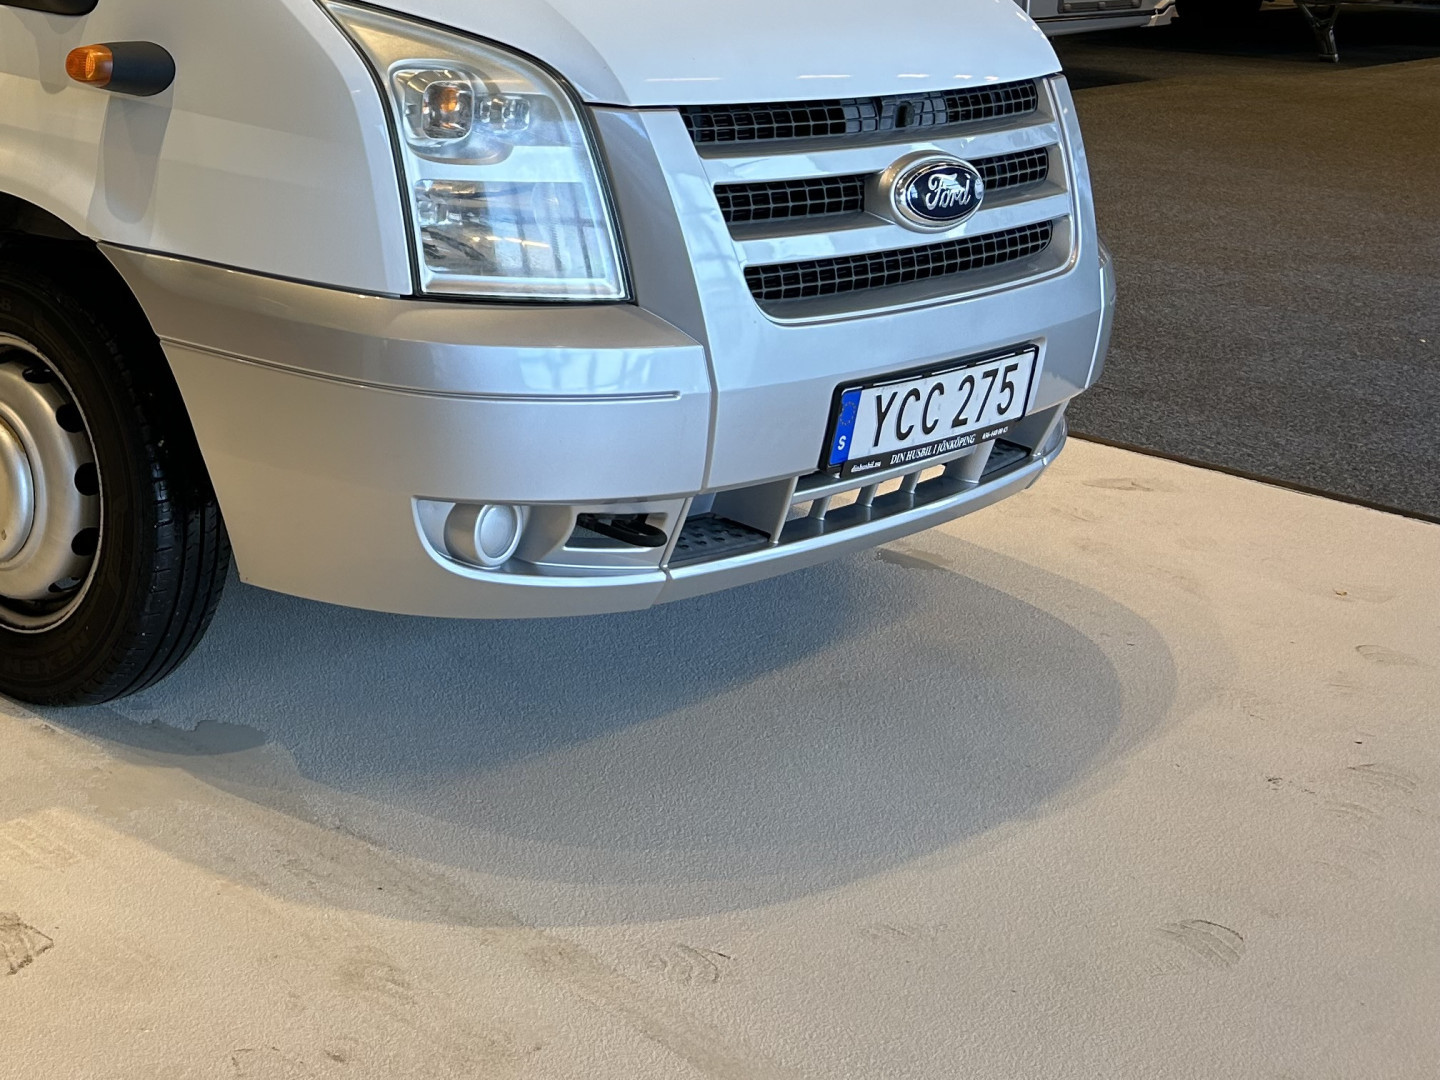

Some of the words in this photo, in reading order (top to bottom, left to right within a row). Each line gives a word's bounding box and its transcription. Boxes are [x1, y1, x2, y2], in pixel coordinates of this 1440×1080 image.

[925, 173, 971, 210] Ford
[873, 382, 944, 447] YCC
[951, 363, 1019, 429] 275
[837, 435, 847, 451] S
[890, 453, 906, 465] DIN
